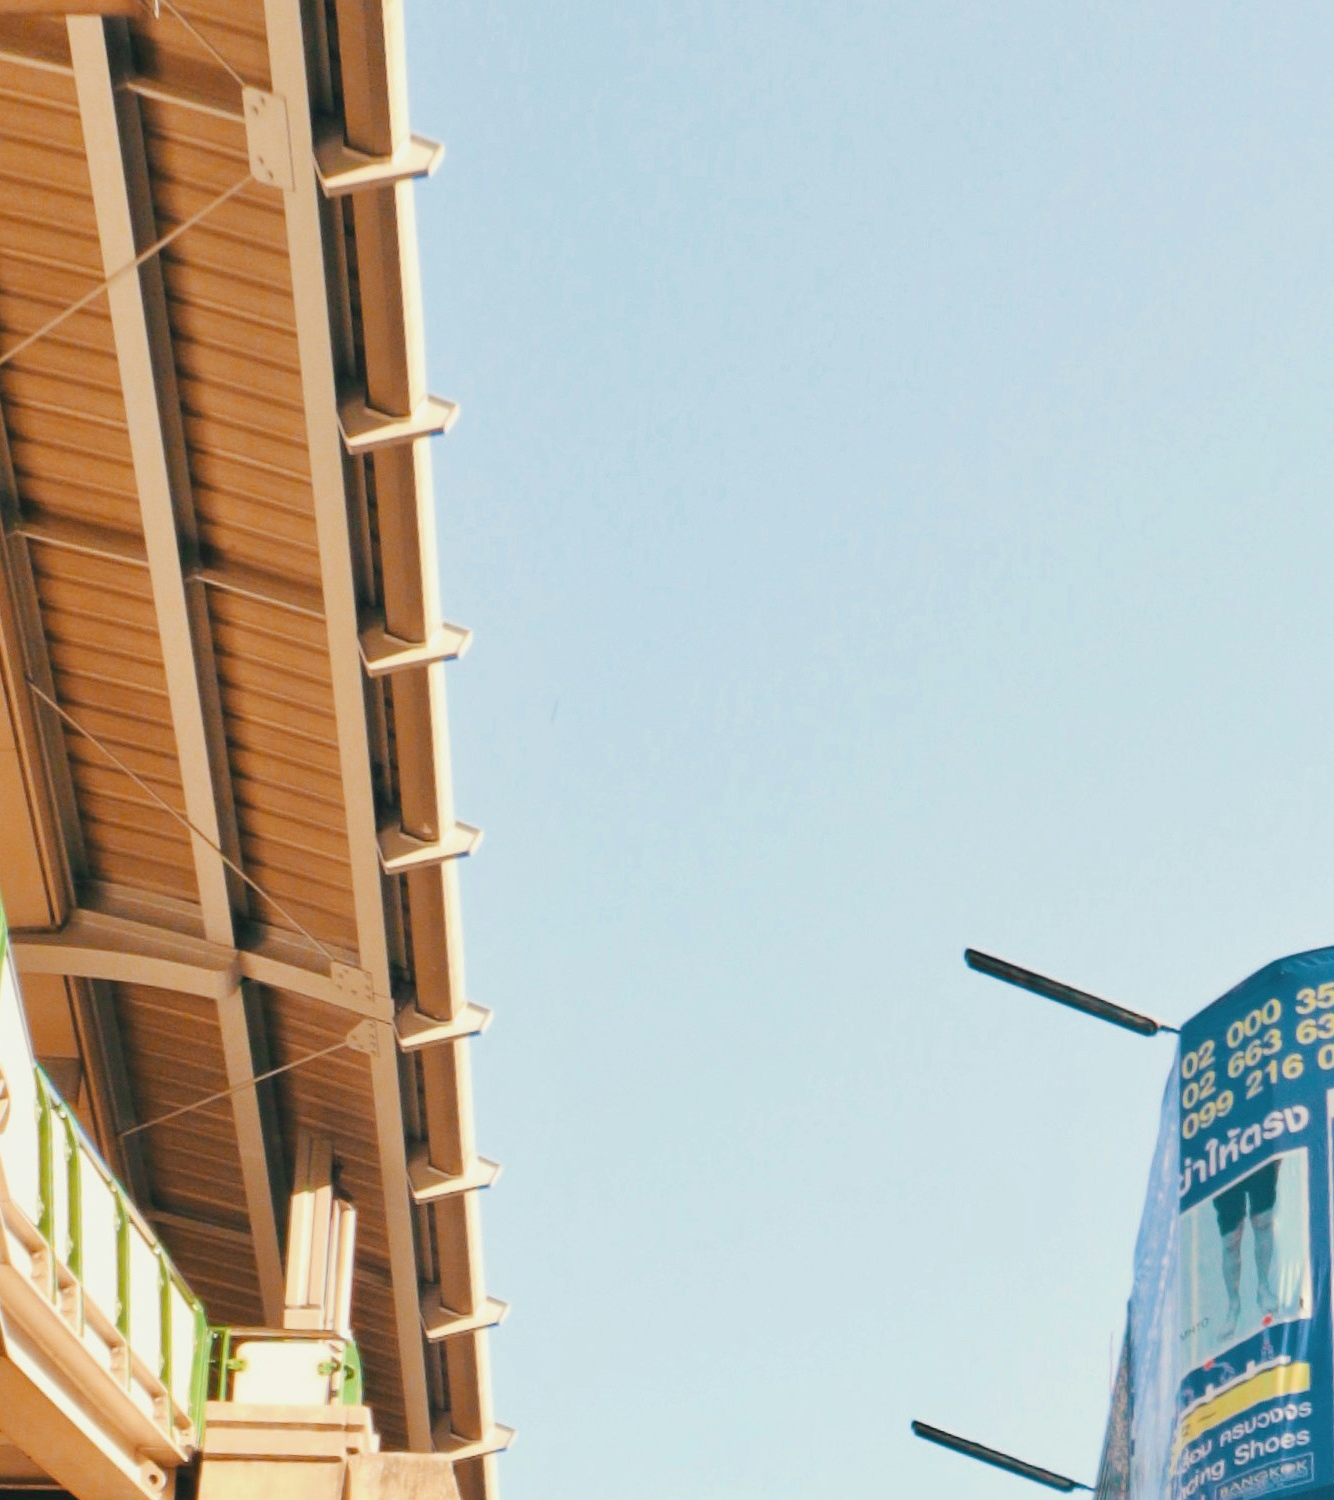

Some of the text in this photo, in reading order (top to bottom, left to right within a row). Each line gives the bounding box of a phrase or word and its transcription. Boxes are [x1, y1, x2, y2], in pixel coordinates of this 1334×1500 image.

[1181, 1039, 1215, 1079] 02
[1226, 998, 1282, 1048] 000
[1182, 1070, 1216, 1110] 02
[1227, 1028, 1282, 1078] 663
[1182, 1089, 1234, 1139] 099
[1245, 1053, 1305, 1100] 216
[1234, 1429, 1311, 1466] Shoes
